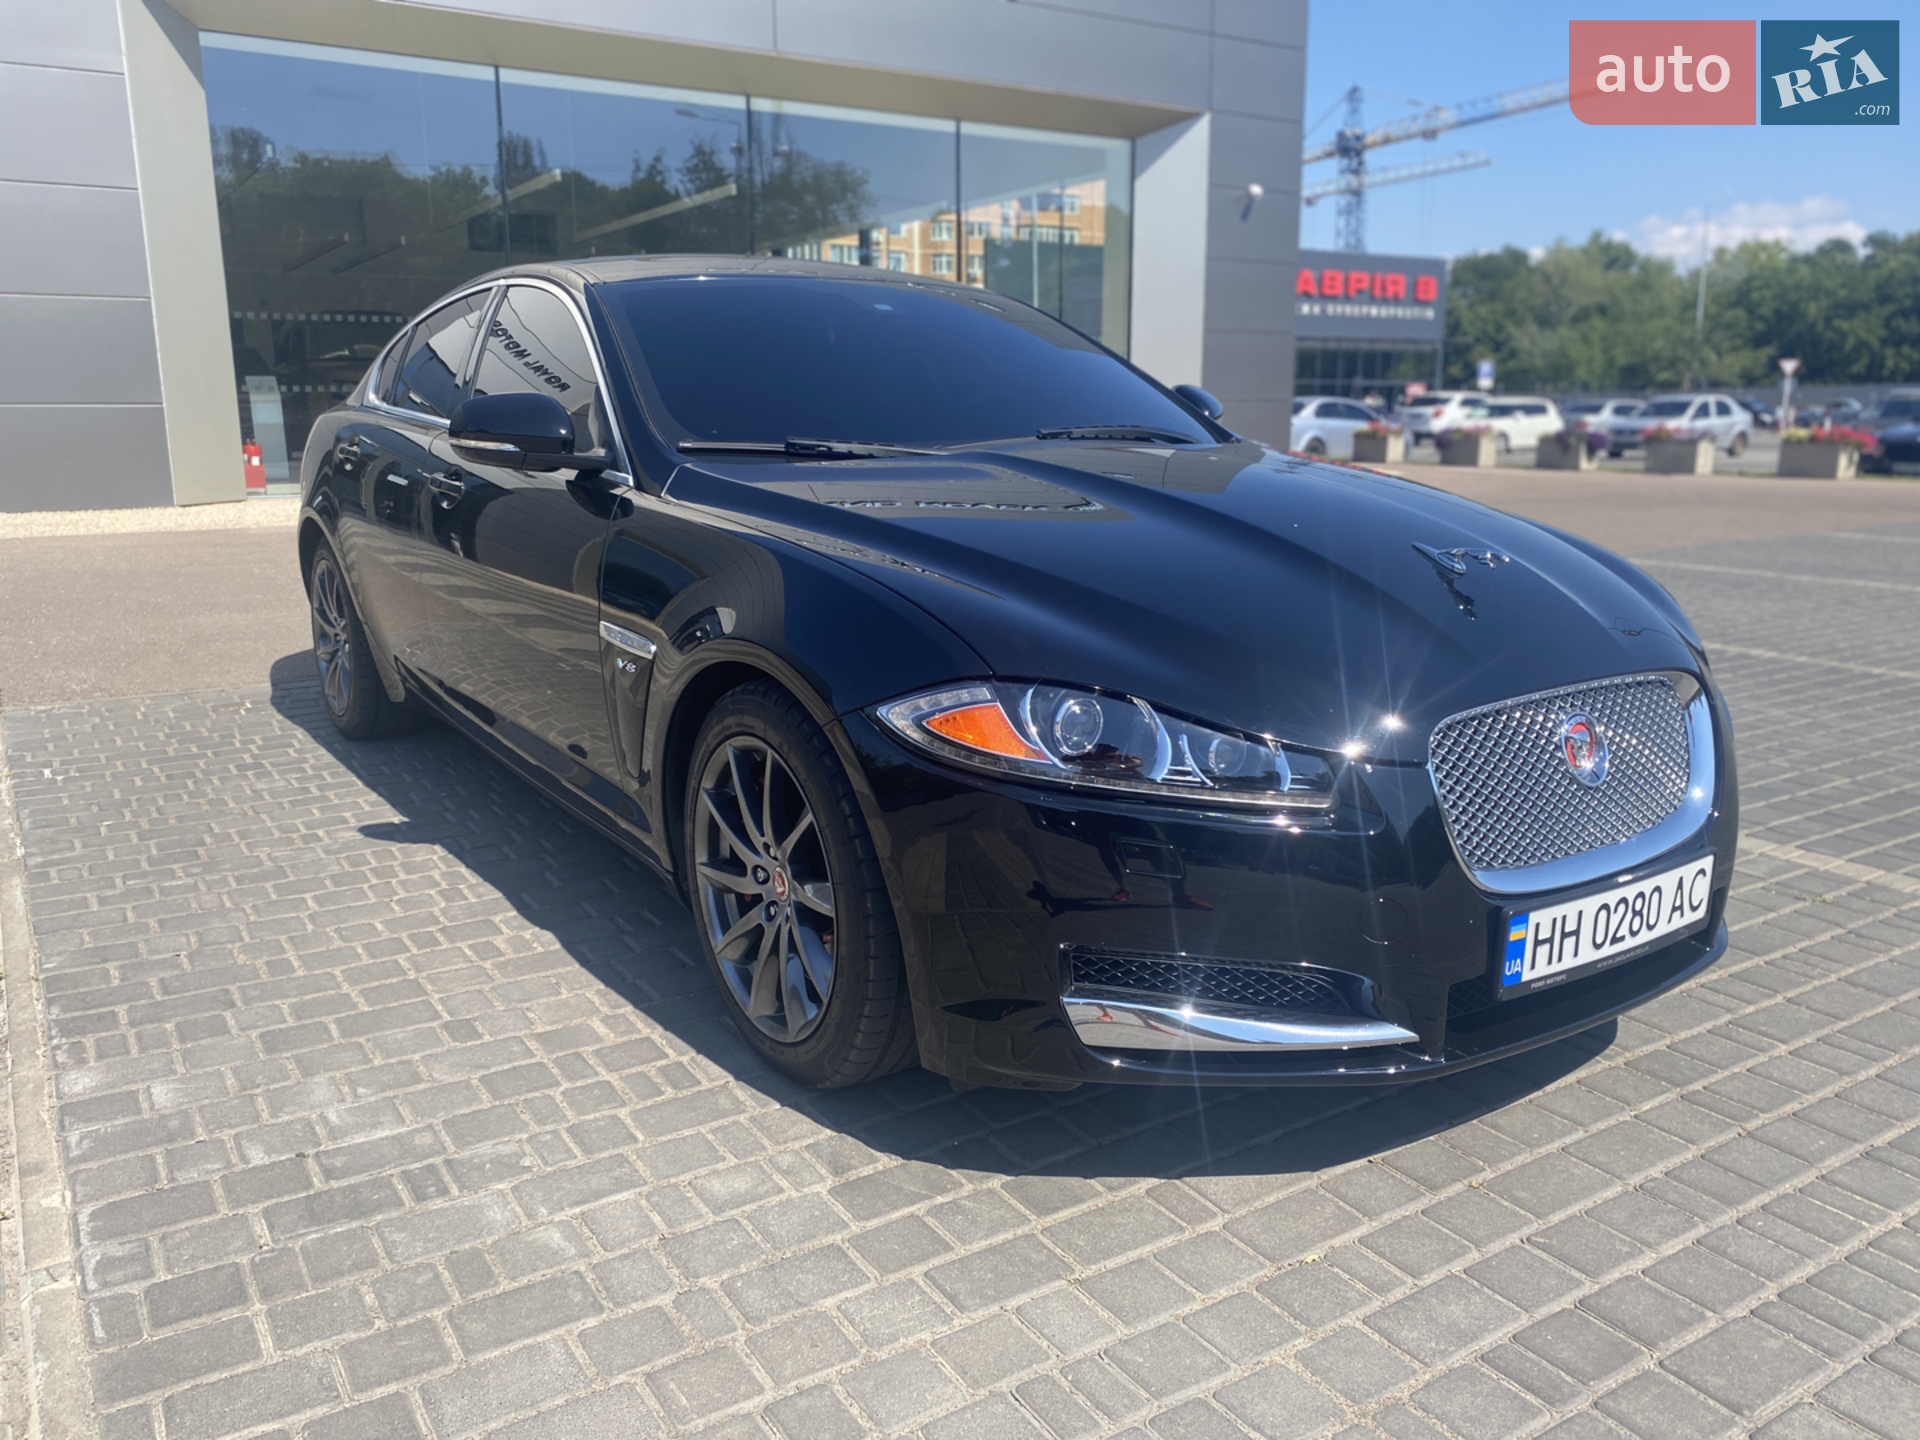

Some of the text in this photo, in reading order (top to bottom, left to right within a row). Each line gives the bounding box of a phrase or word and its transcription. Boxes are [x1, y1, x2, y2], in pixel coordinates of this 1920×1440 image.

[1530, 867, 1707, 972] HH 0280 AC
[1504, 957, 1522, 977] UA
